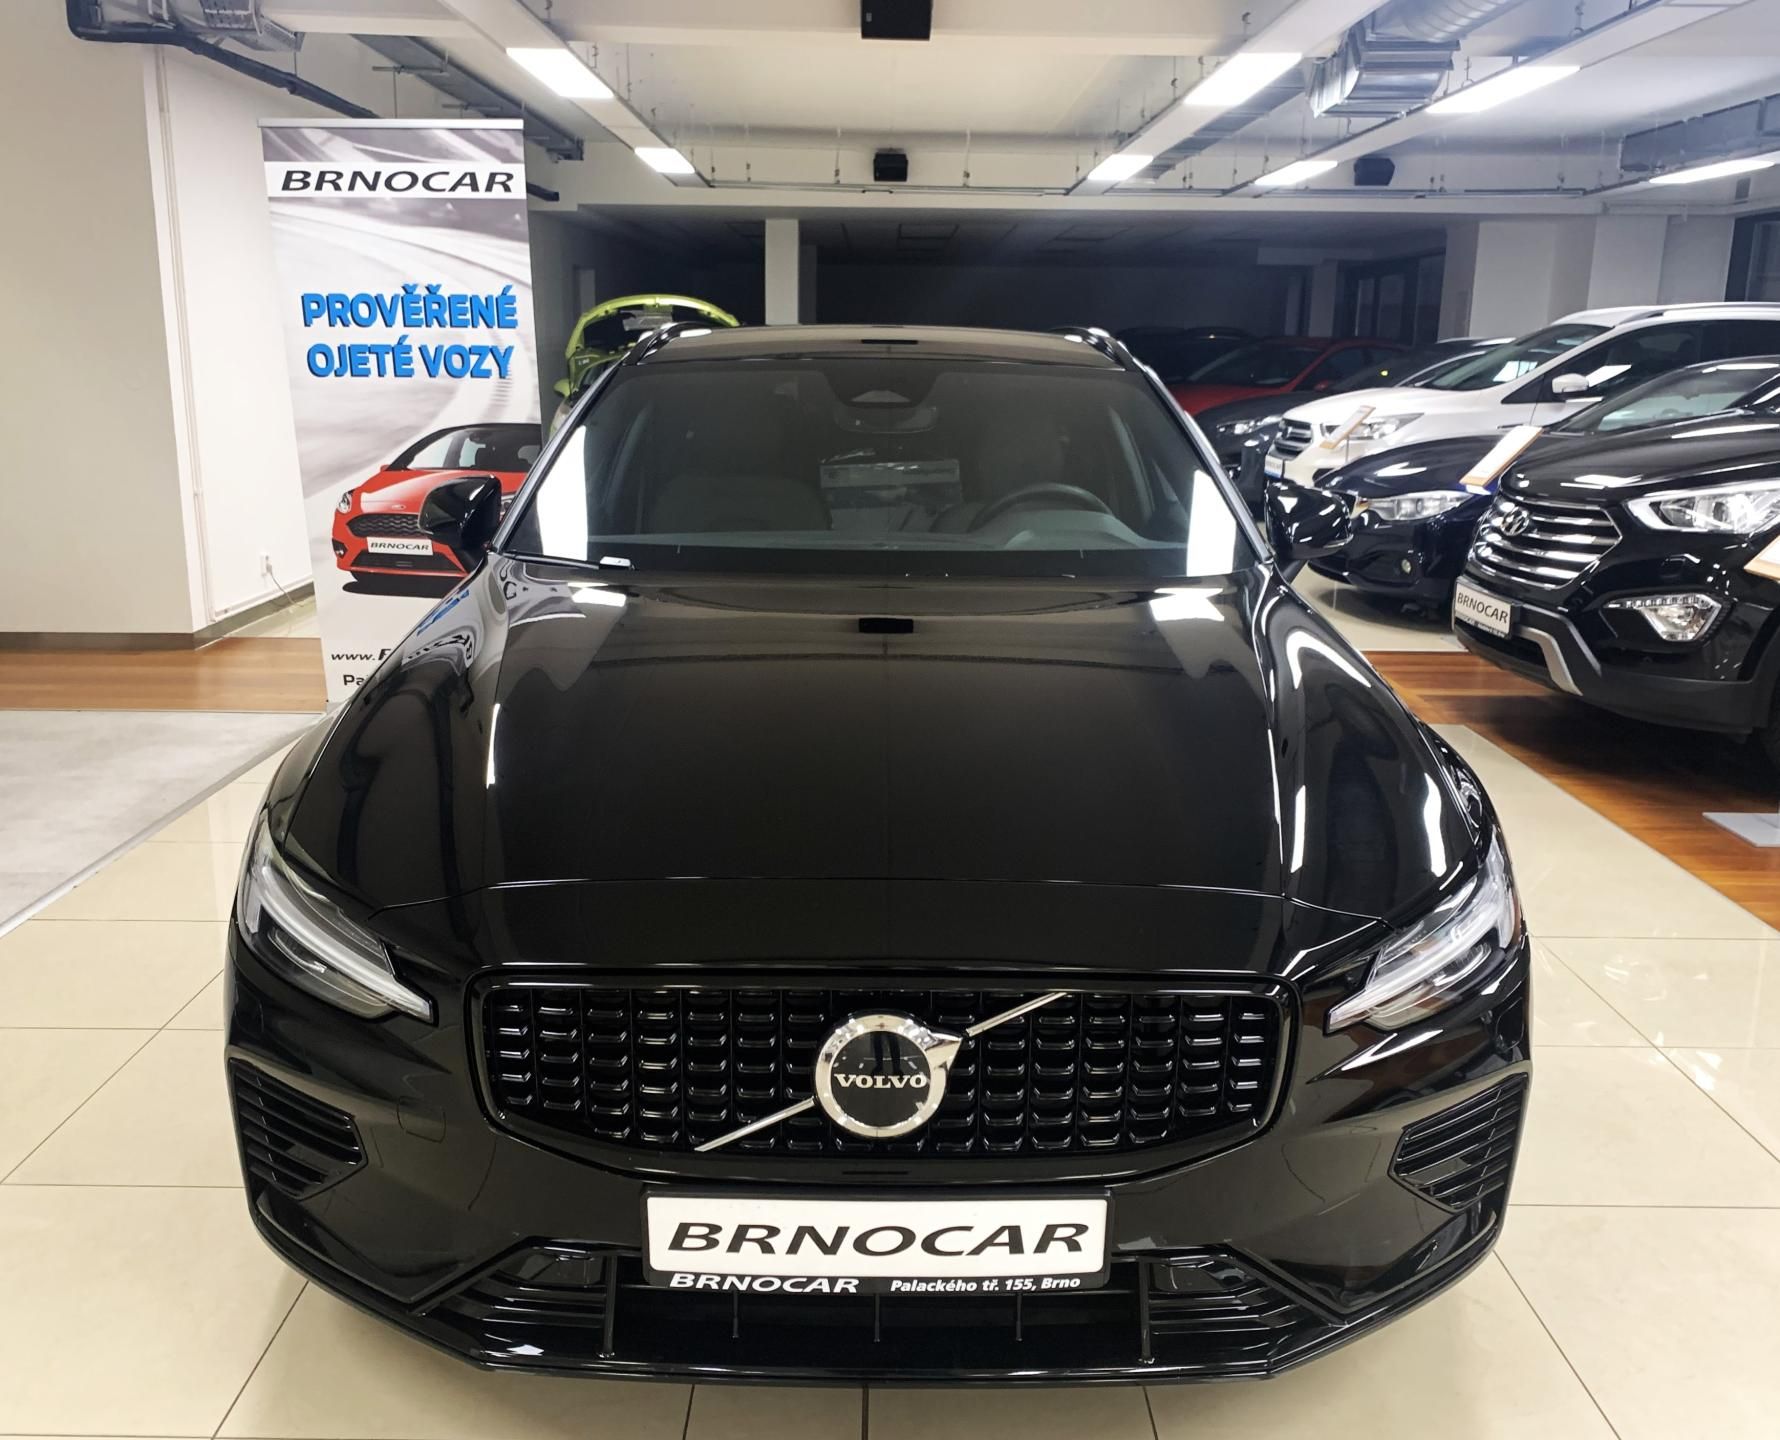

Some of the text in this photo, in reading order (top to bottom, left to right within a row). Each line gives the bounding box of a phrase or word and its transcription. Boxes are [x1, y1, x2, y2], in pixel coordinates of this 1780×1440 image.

[281, 170, 514, 193] BRNOCAR
[301, 284, 518, 329] PROVĚŘENÉ
[306, 335, 514, 379] OJETÉ VOZY
[370, 542, 430, 551] BRNOCAR
[1457, 592, 1508, 625] BRNOCAR
[343, 674, 368, 686] Pa
[834, 1073, 927, 1089] VOLVO
[668, 1222, 1089, 1257] BRNOCAR
[669, 1273, 860, 1293] BRNOCAR
[890, 1277, 1081, 1292] Palackého tř. 155, Brno
